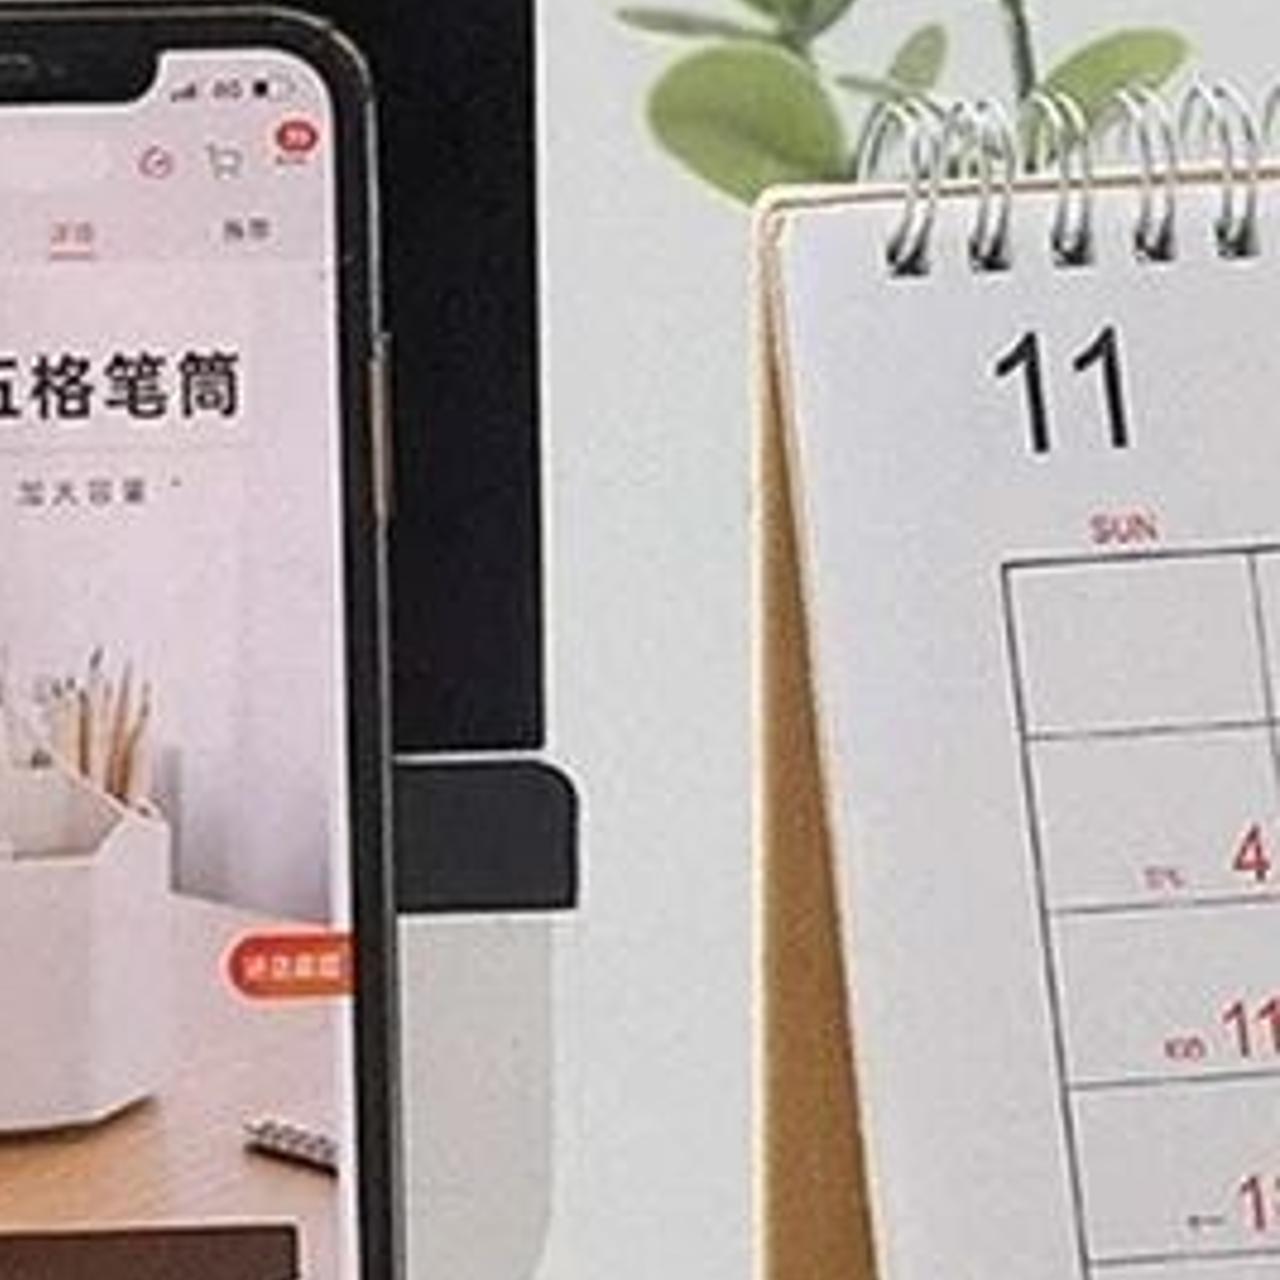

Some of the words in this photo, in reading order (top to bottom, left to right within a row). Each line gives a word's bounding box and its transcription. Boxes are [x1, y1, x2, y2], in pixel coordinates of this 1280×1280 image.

[995, 325, 1130, 455] 11
[1089, 513, 1159, 546] SUN
[1232, 823, 1271, 883] 4
[1222, 1000, 1280, 1058] 11
[1240, 1176, 1280, 1233] 1
